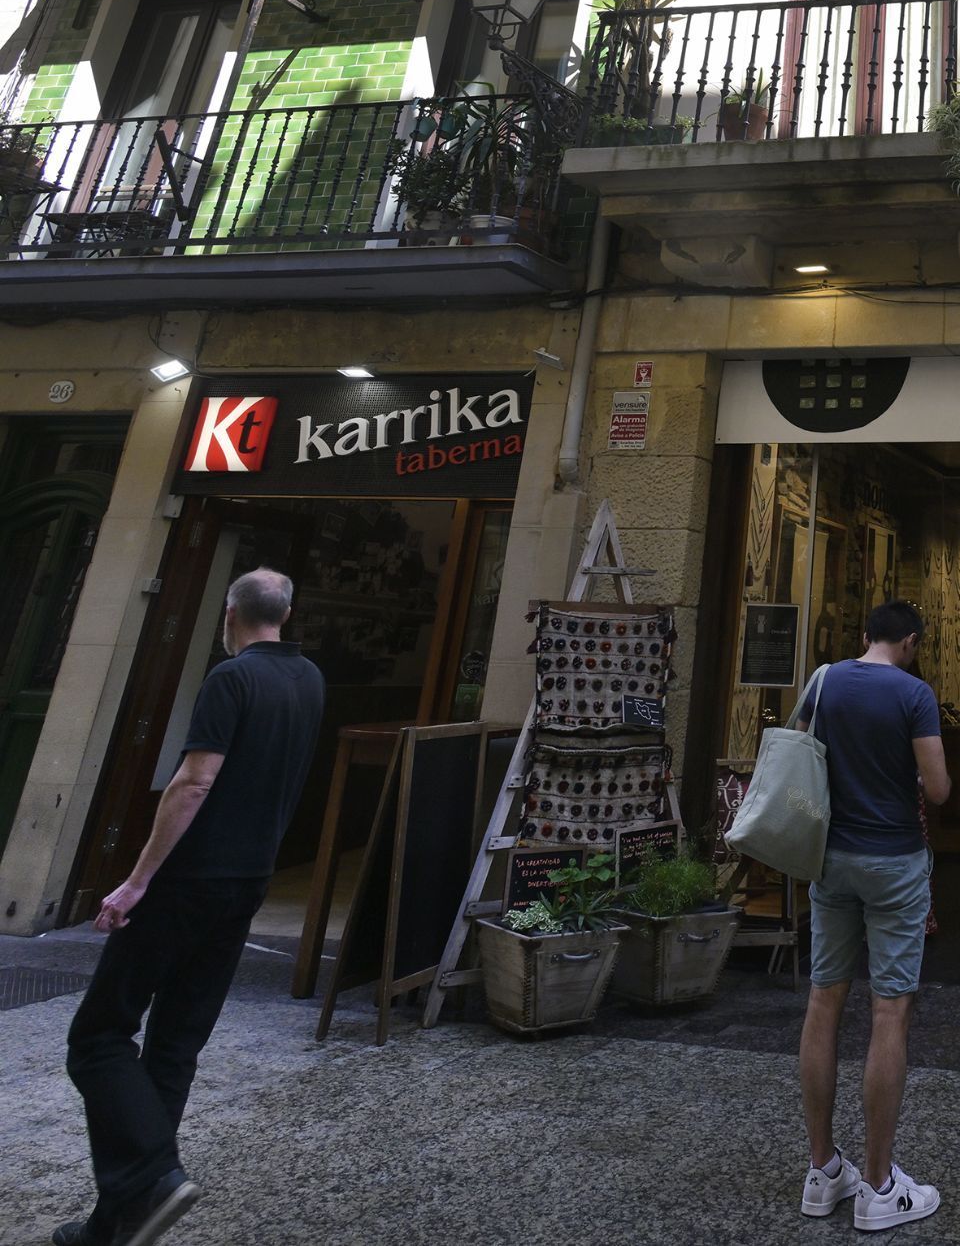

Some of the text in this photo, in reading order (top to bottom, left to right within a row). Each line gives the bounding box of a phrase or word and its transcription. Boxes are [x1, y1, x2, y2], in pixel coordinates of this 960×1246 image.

[50, 384, 71, 399] 26
[293, 387, 525, 464] karrika
[612, 415, 646, 423] Alarma
[395, 433, 522, 475] taberna
